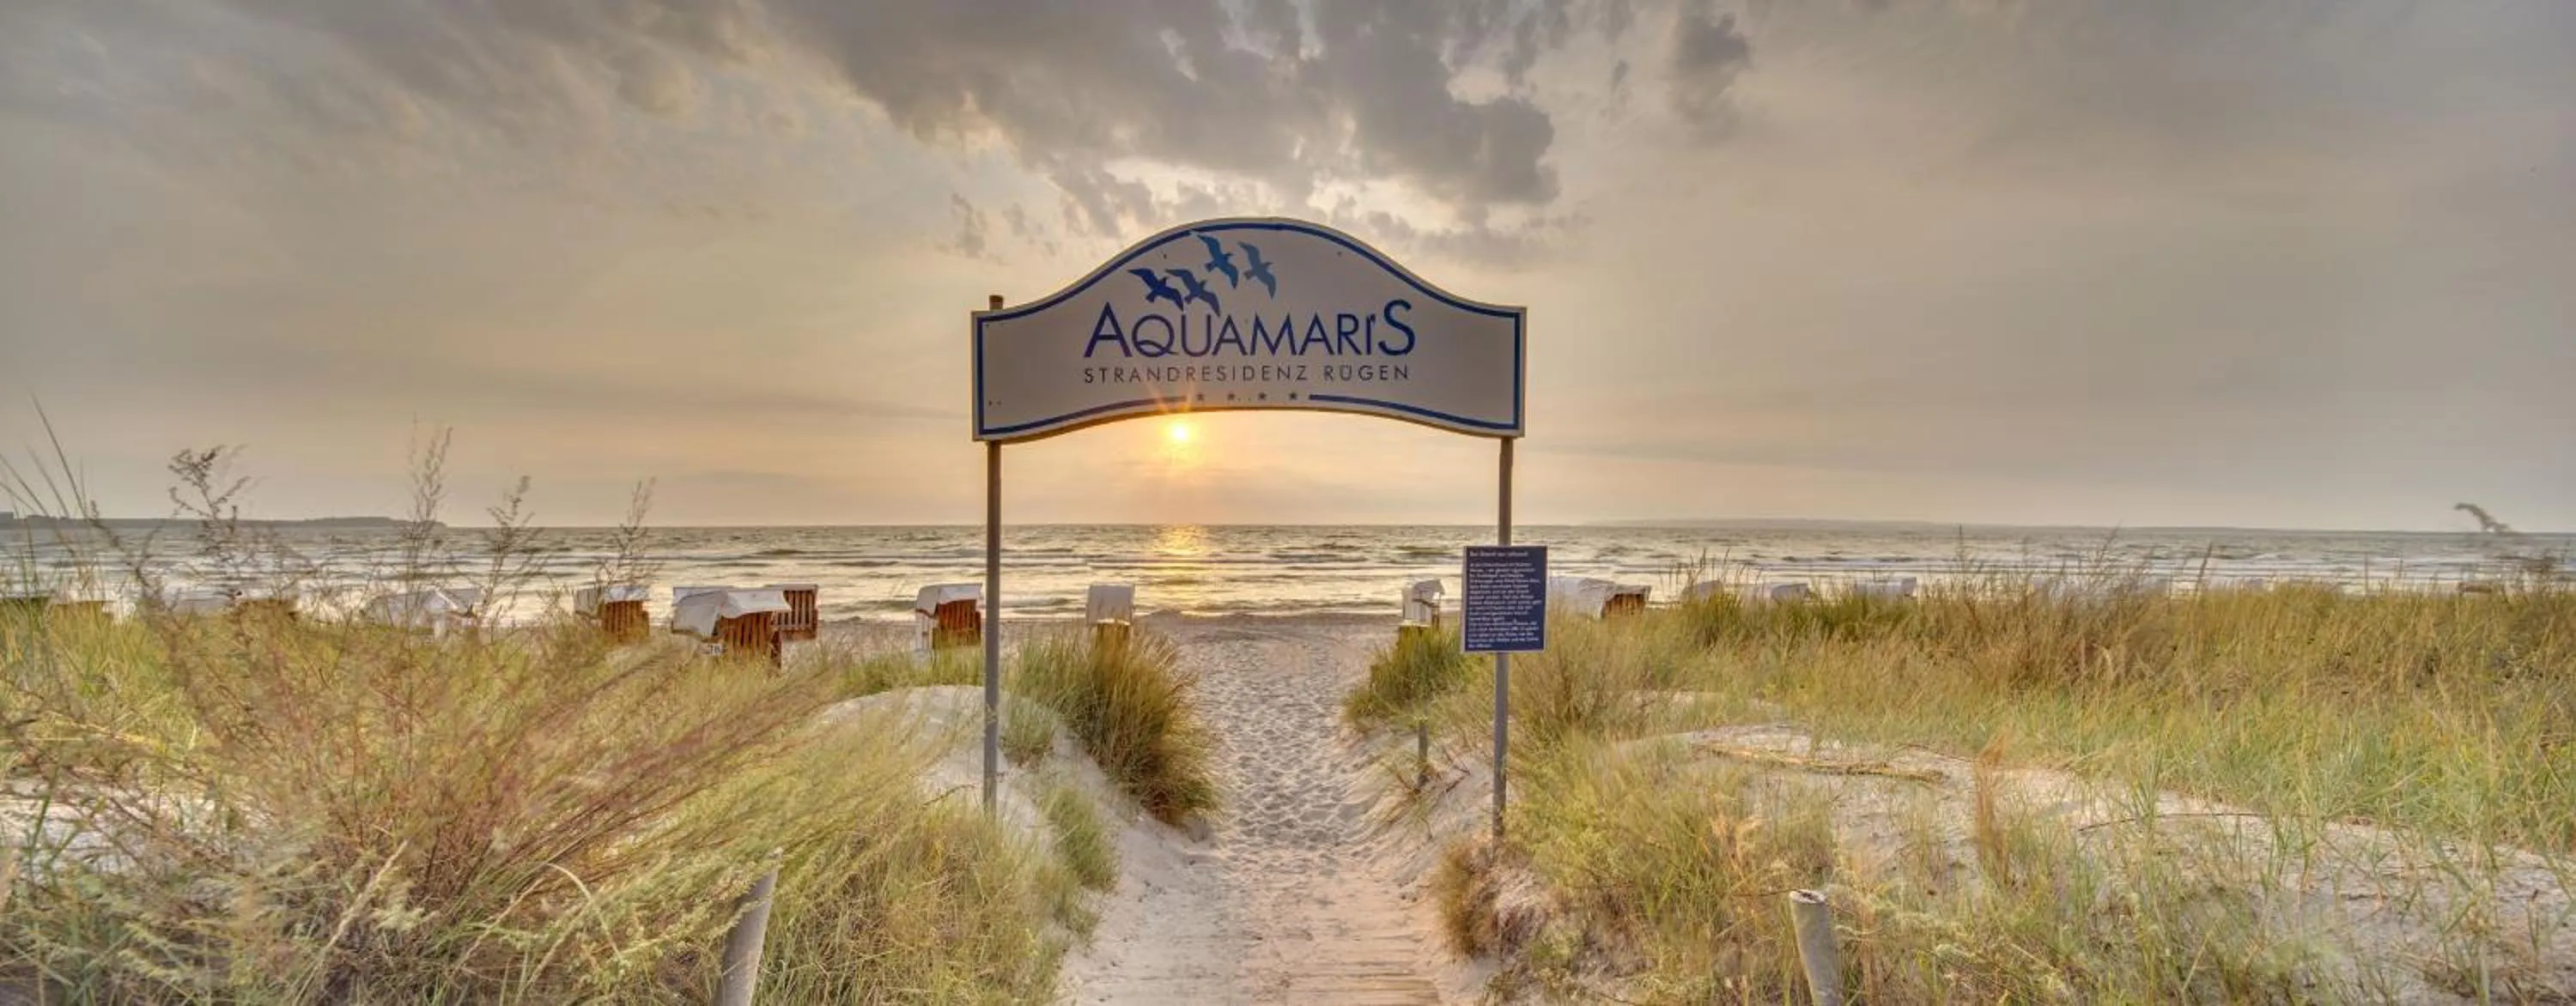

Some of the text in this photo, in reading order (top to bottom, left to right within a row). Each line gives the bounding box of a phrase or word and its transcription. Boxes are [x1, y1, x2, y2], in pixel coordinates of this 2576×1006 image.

[1084, 300, 1416, 358] AQUAMARIS
[1084, 364, 1410, 383] STRANDRESIDENZ RÜGEN
